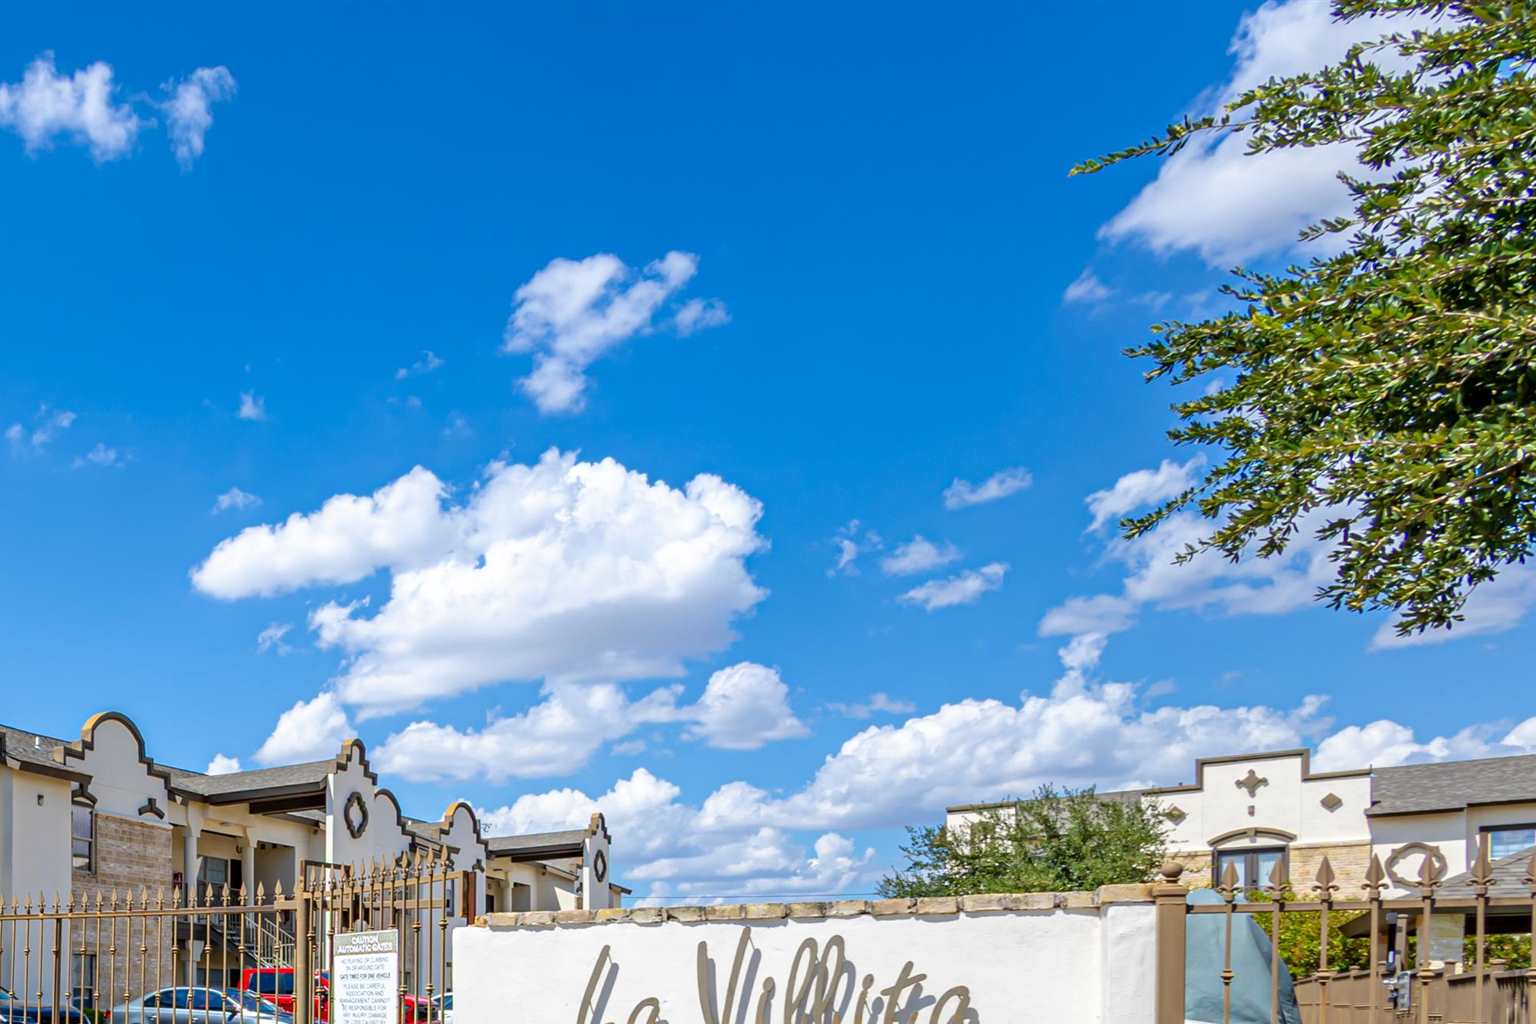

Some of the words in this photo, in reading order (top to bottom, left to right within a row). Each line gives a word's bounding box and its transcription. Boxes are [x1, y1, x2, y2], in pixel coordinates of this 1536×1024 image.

[352, 936, 378, 944] CAUTION
[337, 944, 371, 952] AUTOMATIC
[372, 942, 393, 951] GATES
